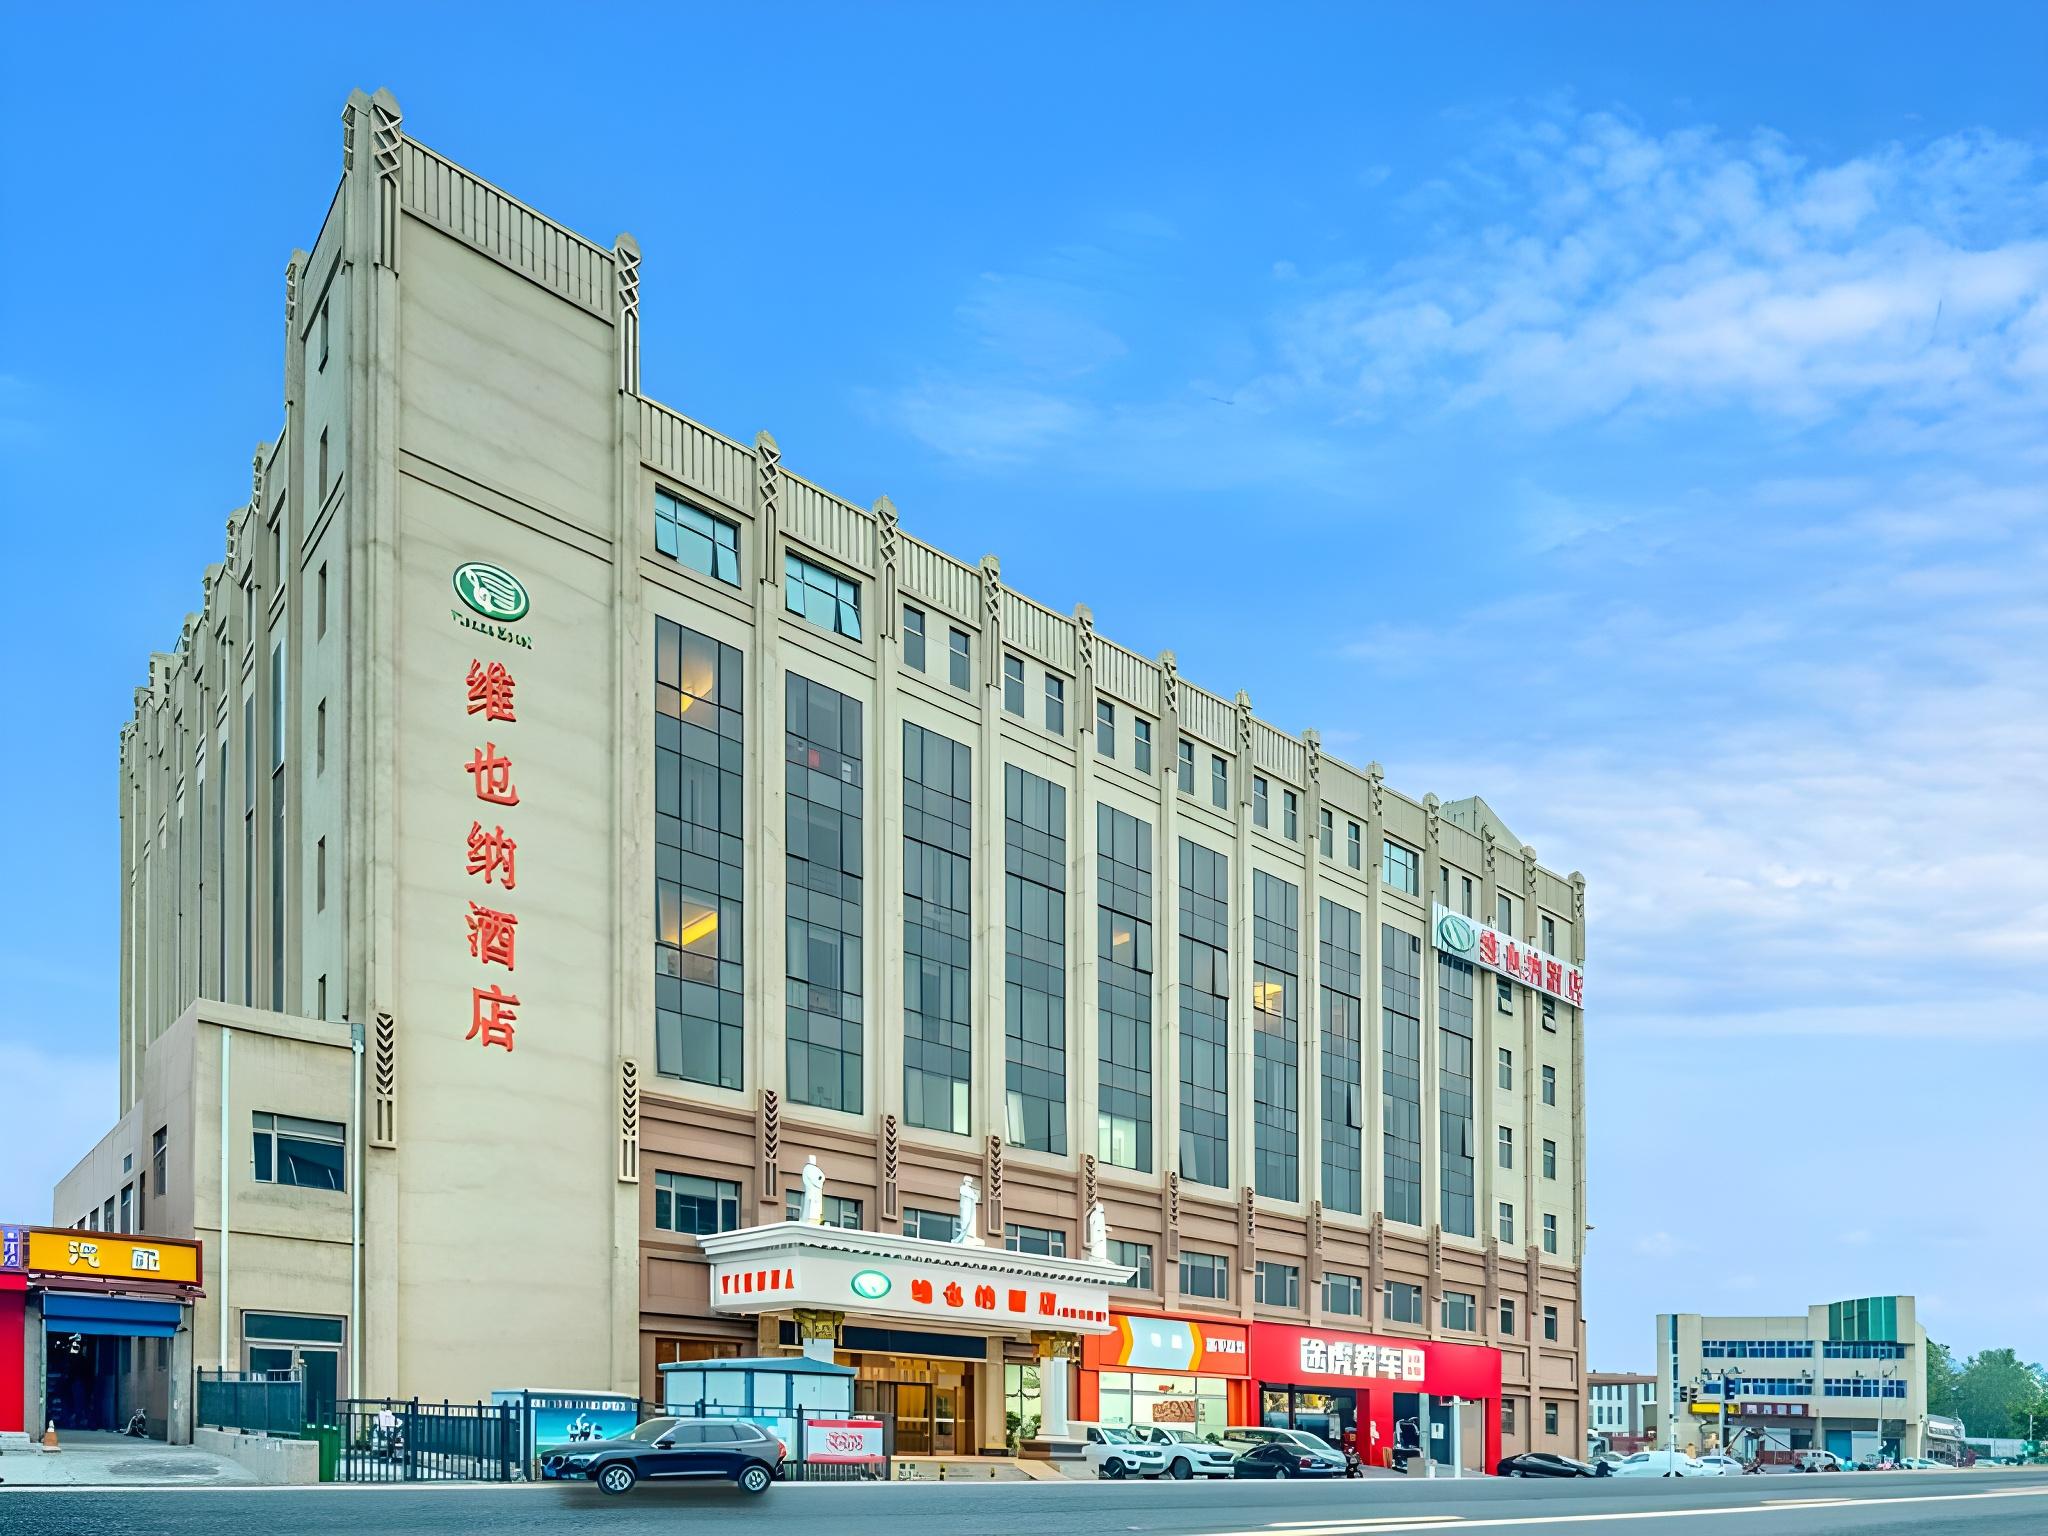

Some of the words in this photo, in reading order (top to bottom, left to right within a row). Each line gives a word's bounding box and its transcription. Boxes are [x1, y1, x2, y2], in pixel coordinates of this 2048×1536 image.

[464, 659, 519, 1052] 维也纳酒店
